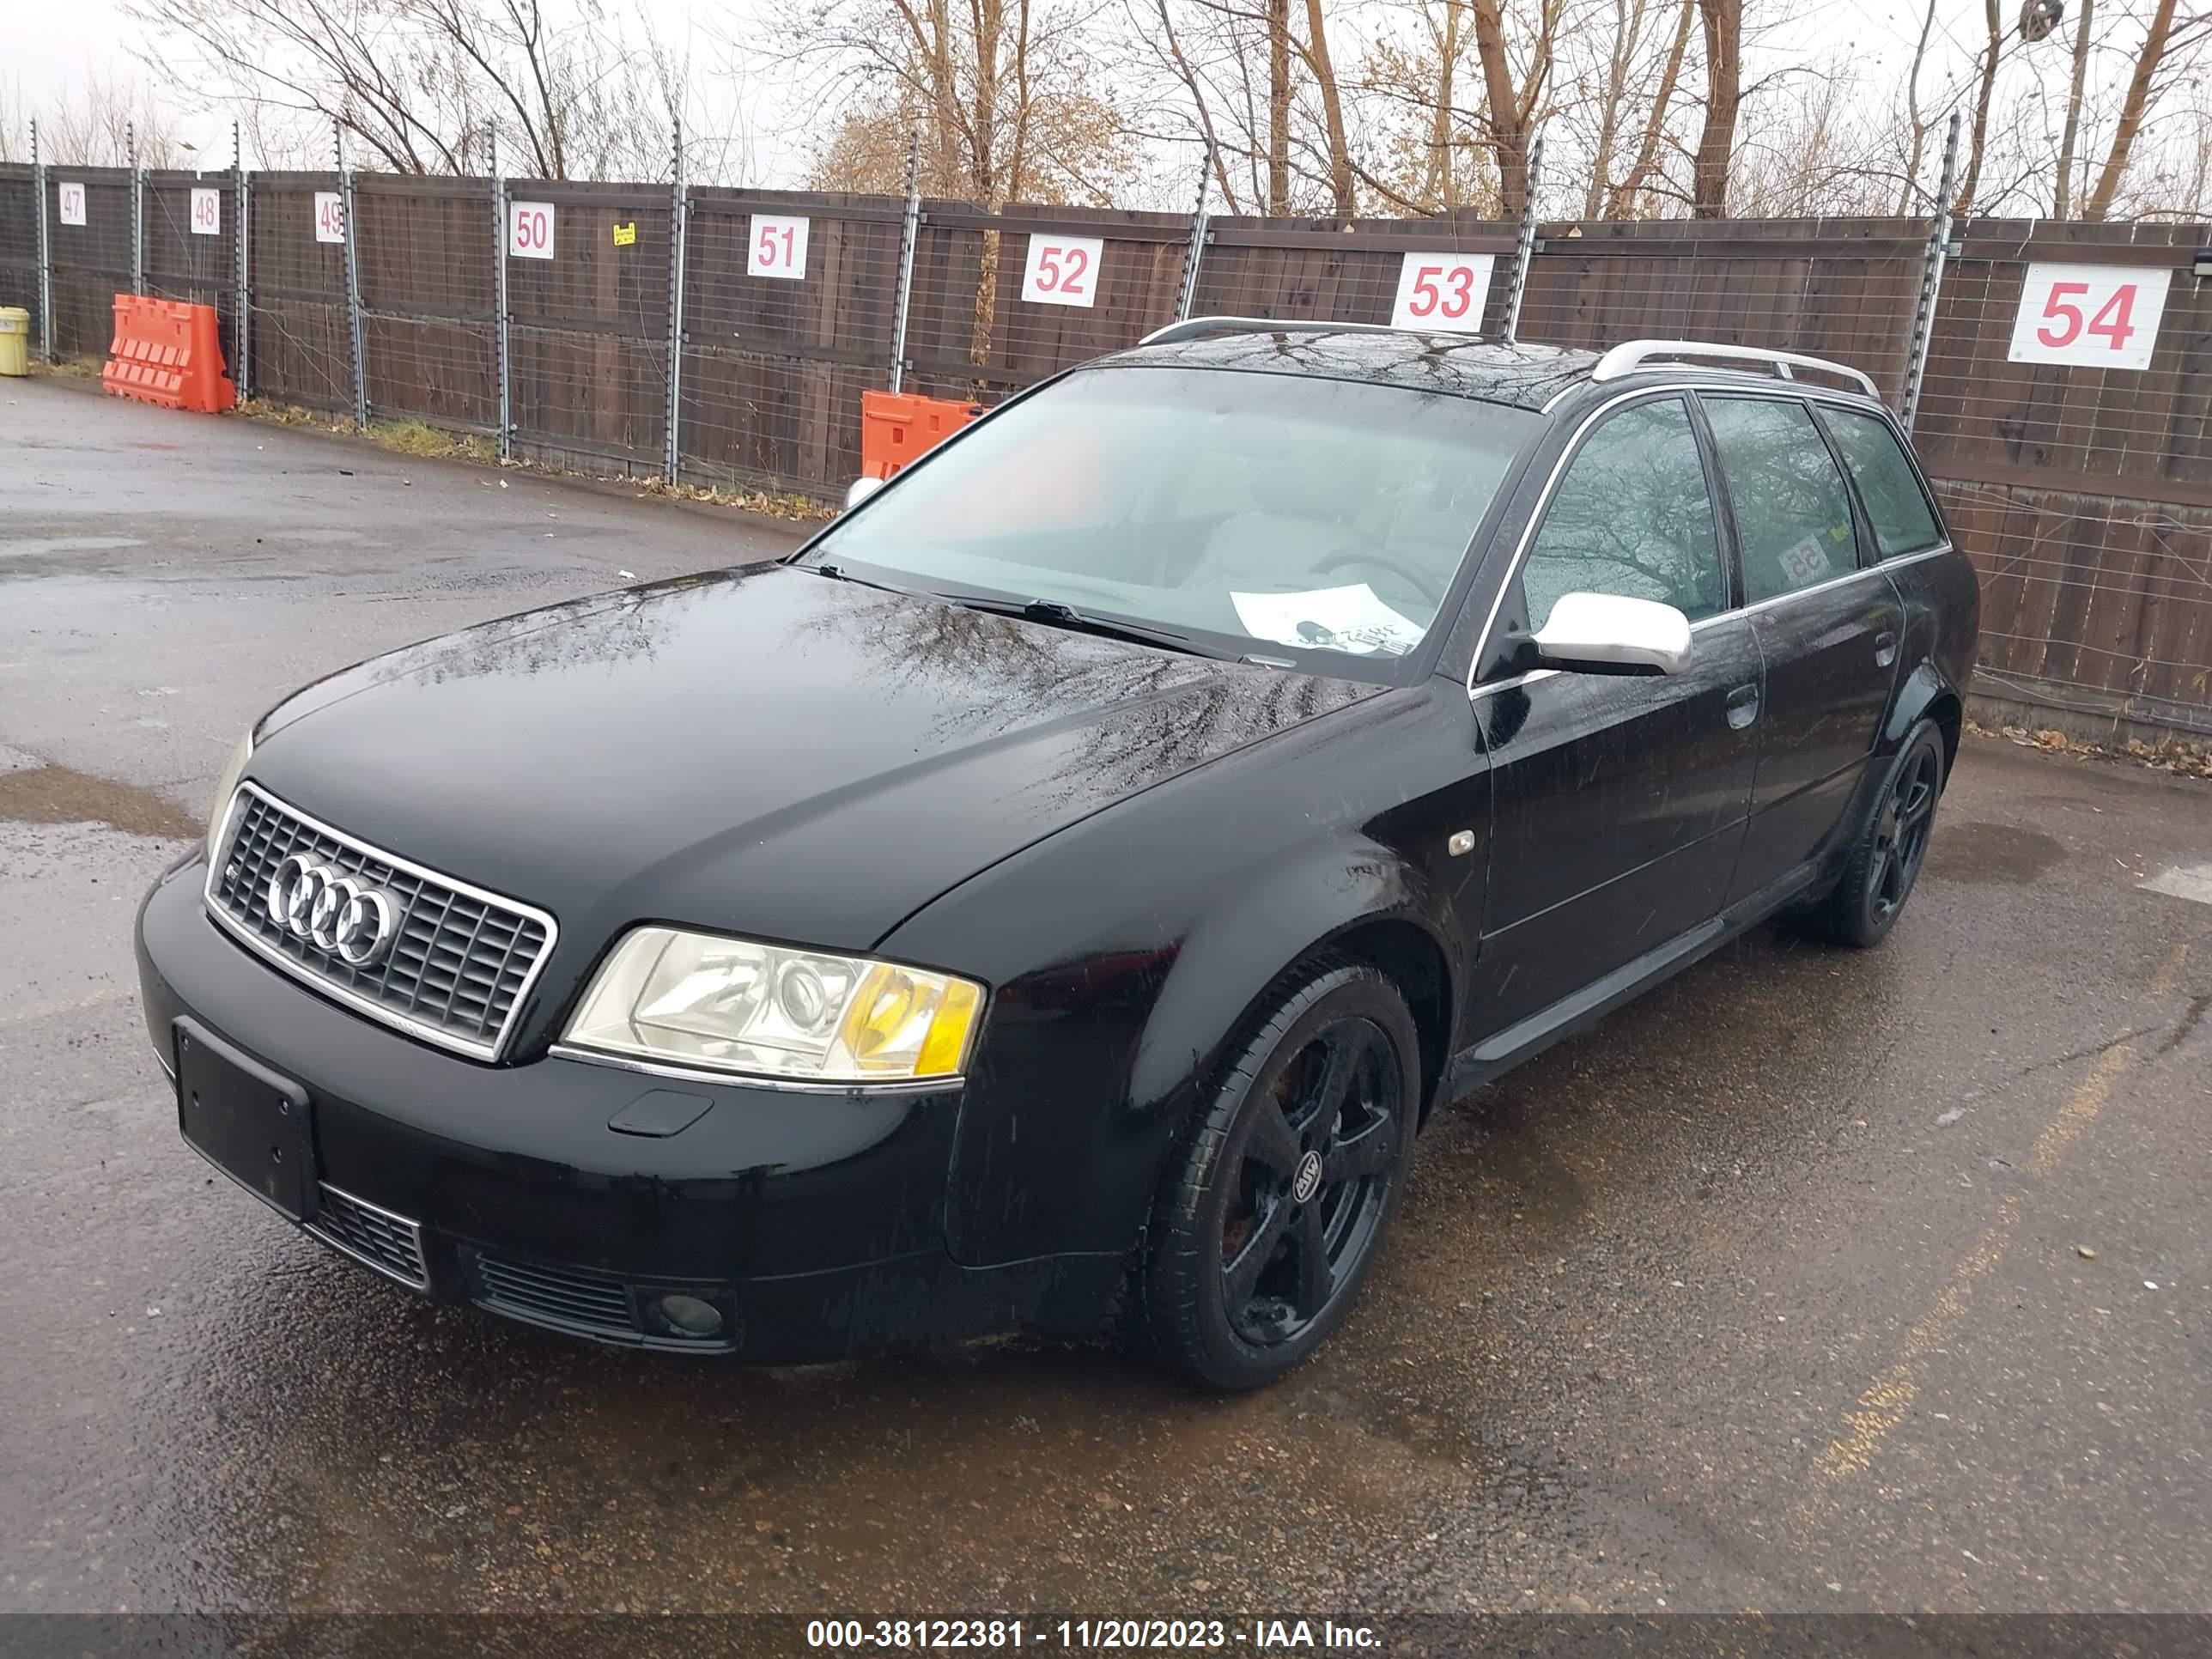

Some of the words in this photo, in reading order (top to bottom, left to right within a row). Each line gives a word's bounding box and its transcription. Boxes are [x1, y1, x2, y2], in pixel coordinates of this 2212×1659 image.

[64, 191, 80, 216] 47
[196, 197, 214, 227] 48
[321, 201, 341, 234] 49
[516, 210, 547, 249] 50
[757, 225, 794, 267] 51
[1035, 246, 1089, 295] 52
[1408, 265, 1475, 319] 53
[2036, 281, 2138, 349] 54
